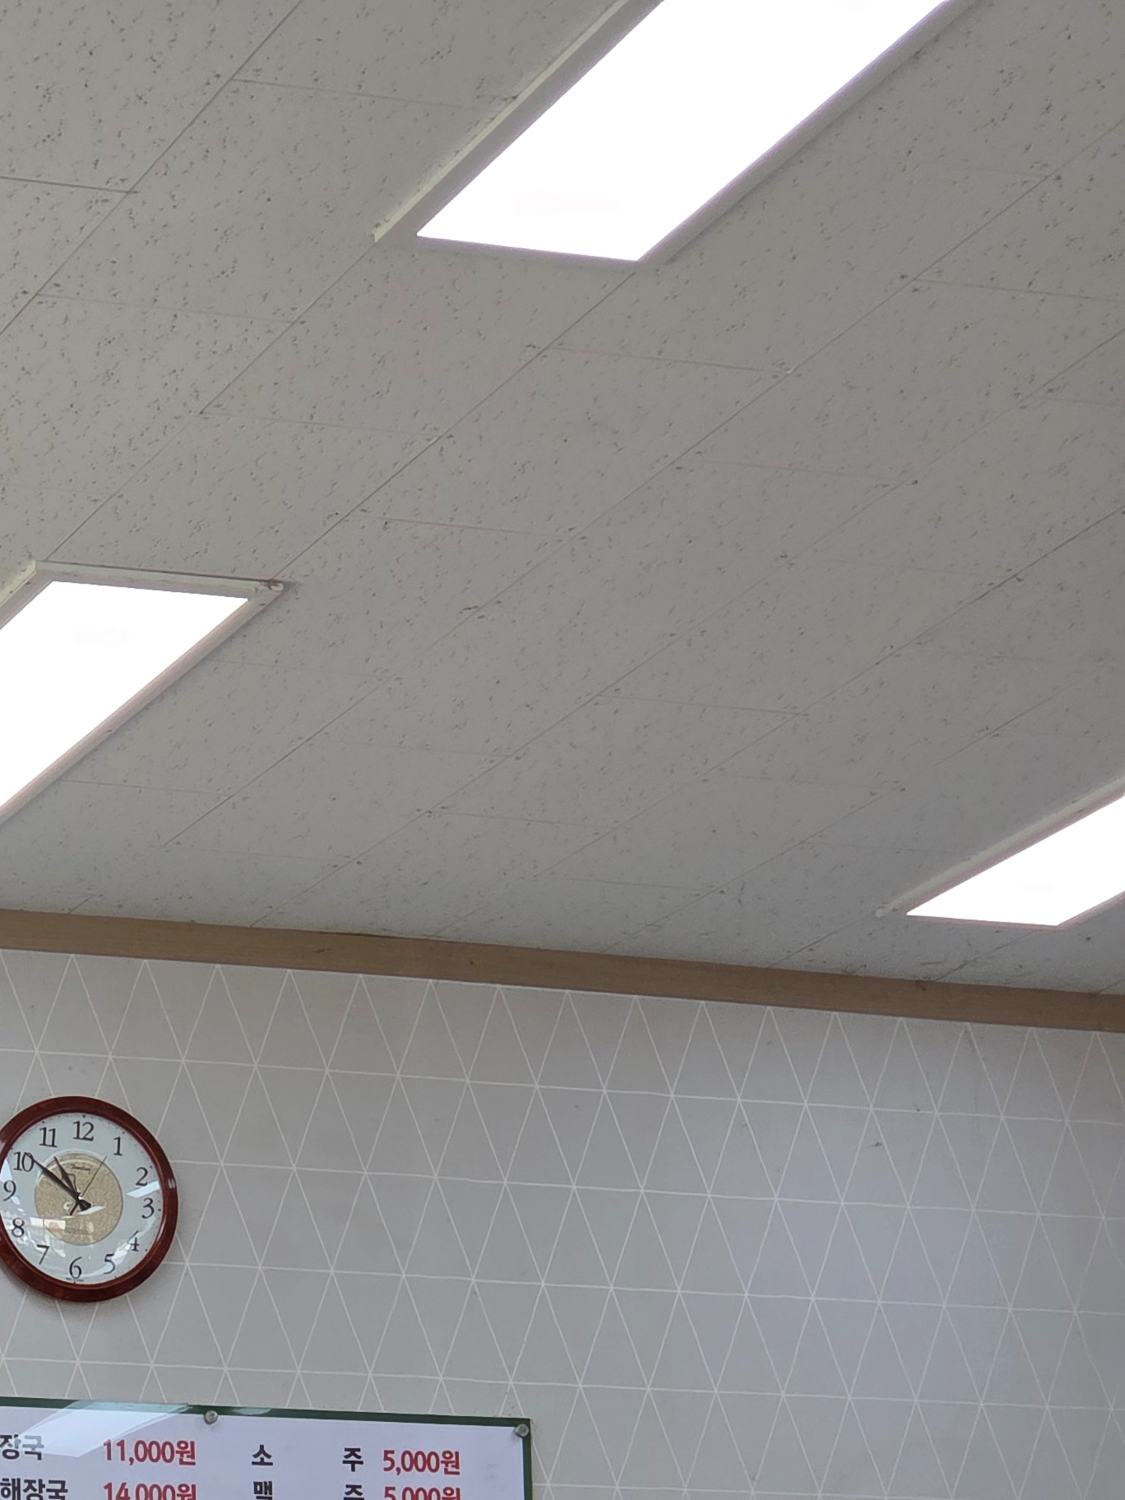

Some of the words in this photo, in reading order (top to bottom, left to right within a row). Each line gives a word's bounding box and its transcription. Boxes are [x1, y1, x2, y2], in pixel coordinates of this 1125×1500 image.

[39, 1127, 58, 1148] 11
[73, 1121, 94, 1141] 12
[113, 1137, 123, 1156] 1
[13, 1152, 34, 1172] 10
[136, 1167, 148, 1186] 2
[3, 1180, 16, 1201] 9
[141, 1198, 154, 1219] 3
[11, 1217, 25, 1238] 8
[129, 1230, 140, 1251] 4
[37, 1244, 49, 1265] 7
[104, 1253, 116, 1274] 5
[69, 1257, 82, 1279] 6
[103, 1439, 197, 1466] 11,000원
[251, 1444, 274, 1467] 소
[342, 1447, 364, 1472] 주
[383, 1449, 461, 1476] 5,000원
